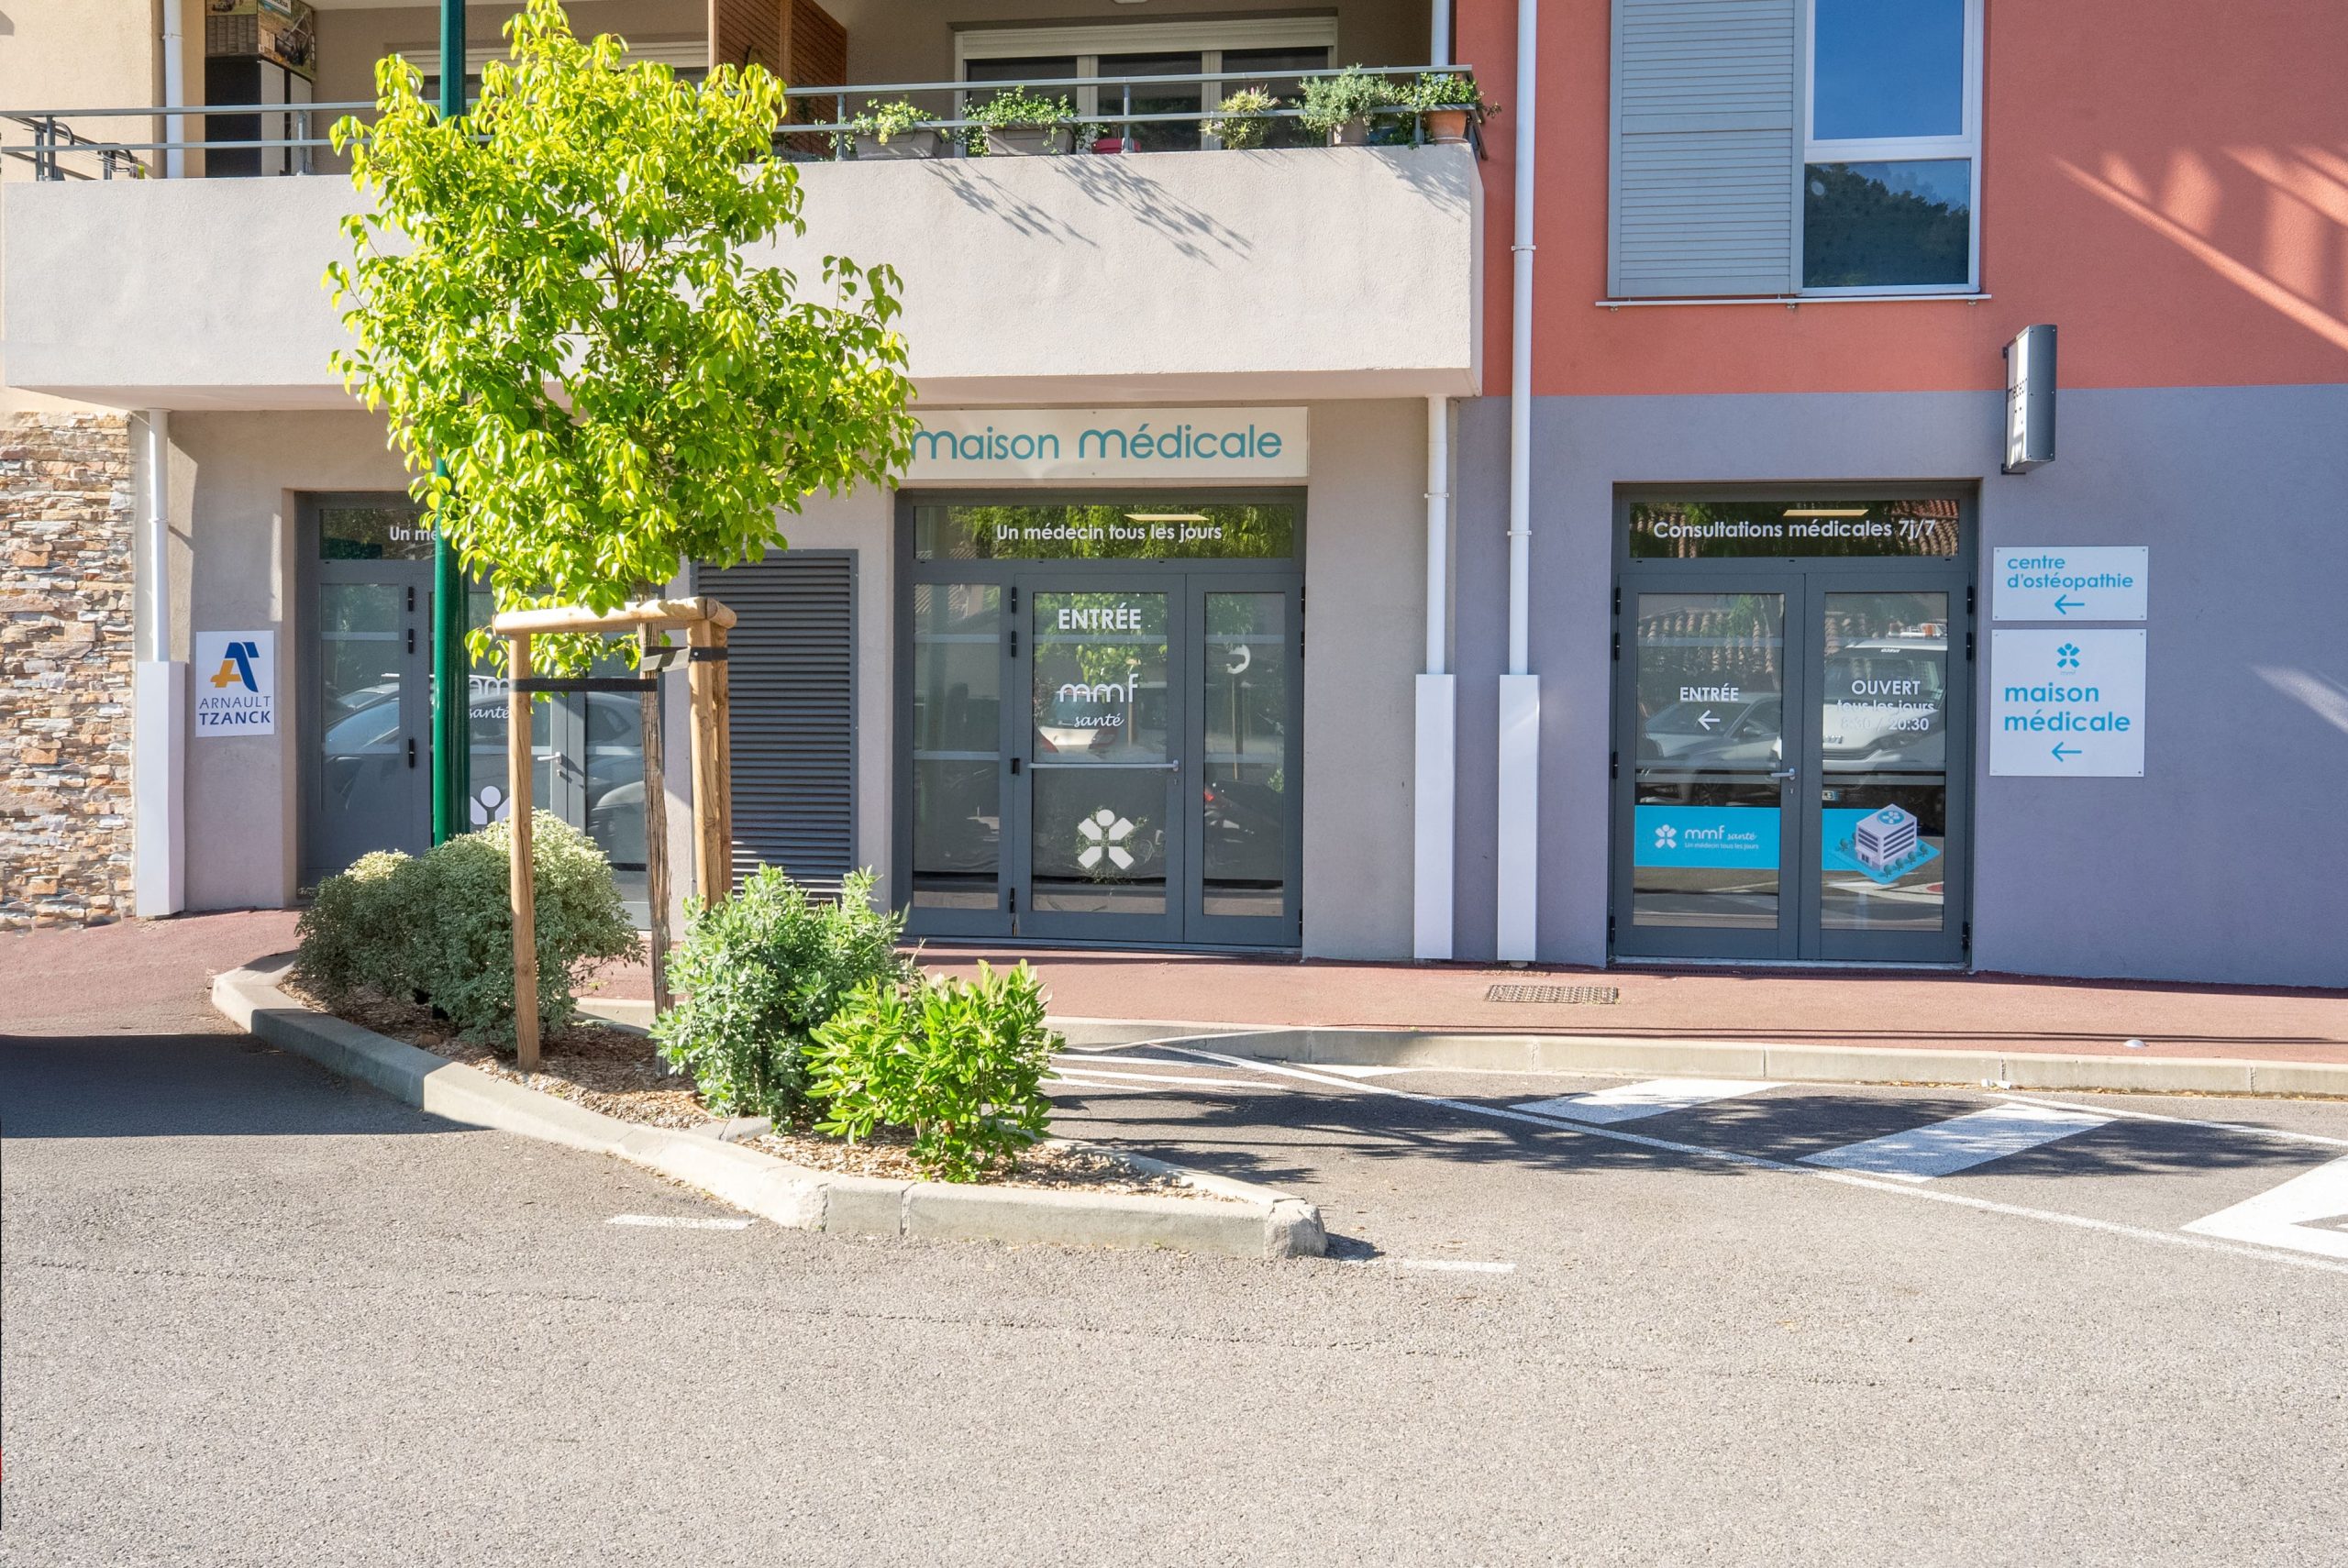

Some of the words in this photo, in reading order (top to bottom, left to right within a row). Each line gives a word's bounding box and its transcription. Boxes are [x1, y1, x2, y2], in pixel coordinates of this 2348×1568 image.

[911, 425, 1059, 460] maison
[1079, 423, 1282, 459] médicale
[389, 525, 410, 541] Un
[996, 525, 1019, 540] Un
[1024, 523, 1104, 540] médecin
[1109, 525, 1146, 540] tous
[1150, 525, 1175, 540] les
[1178, 525, 1223, 544] jours
[1654, 520, 1783, 538] Consultations
[1789, 519, 1892, 537] médicales
[1898, 519, 1936, 539] 7j/7
[2007, 555, 2066, 569] centre
[2007, 571, 2133, 591] d'ostéopathie
[1058, 602, 1142, 630] ENTRÉE
[1059, 673, 1139, 703] mmf
[1679, 682, 1740, 702] ENTRÉE
[1851, 679, 1921, 695] OUVERT
[2004, 681, 2099, 702] maison
[199, 695, 271, 710] ARNAULT
[1836, 700, 1869, 712] tous
[1873, 700, 1894, 712] les
[1896, 700, 1934, 715] jours
[198, 711, 271, 725] TZANCK
[1073, 712, 1124, 728] santé
[1888, 718, 1929, 731] 20:30
[2004, 709, 2131, 732] médicale
[1685, 825, 1725, 839] mmf
[1727, 832, 1756, 841] santé
